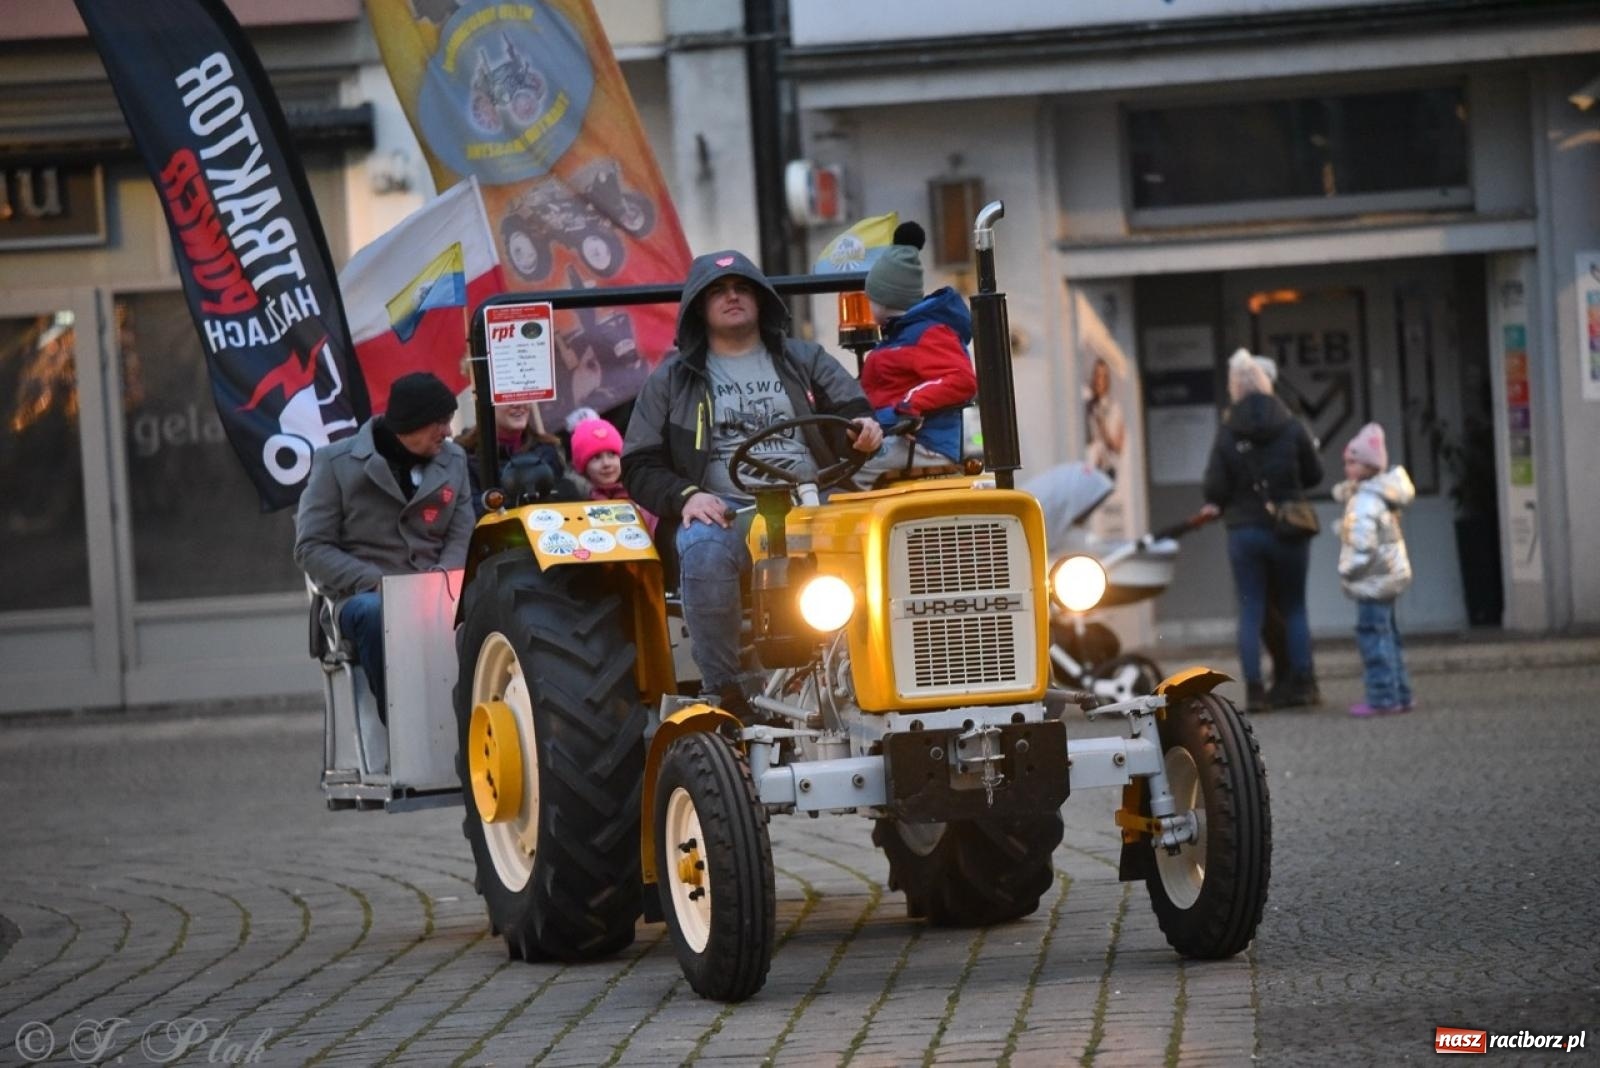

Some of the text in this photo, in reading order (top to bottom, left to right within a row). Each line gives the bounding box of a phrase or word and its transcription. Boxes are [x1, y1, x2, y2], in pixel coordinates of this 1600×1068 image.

[491, 323, 516, 343] rpt
[1267, 331, 1351, 367] TEB
[745, 380, 788, 396] SWO
[133, 403, 227, 457] gela
[910, 596, 1010, 615] URSUS
